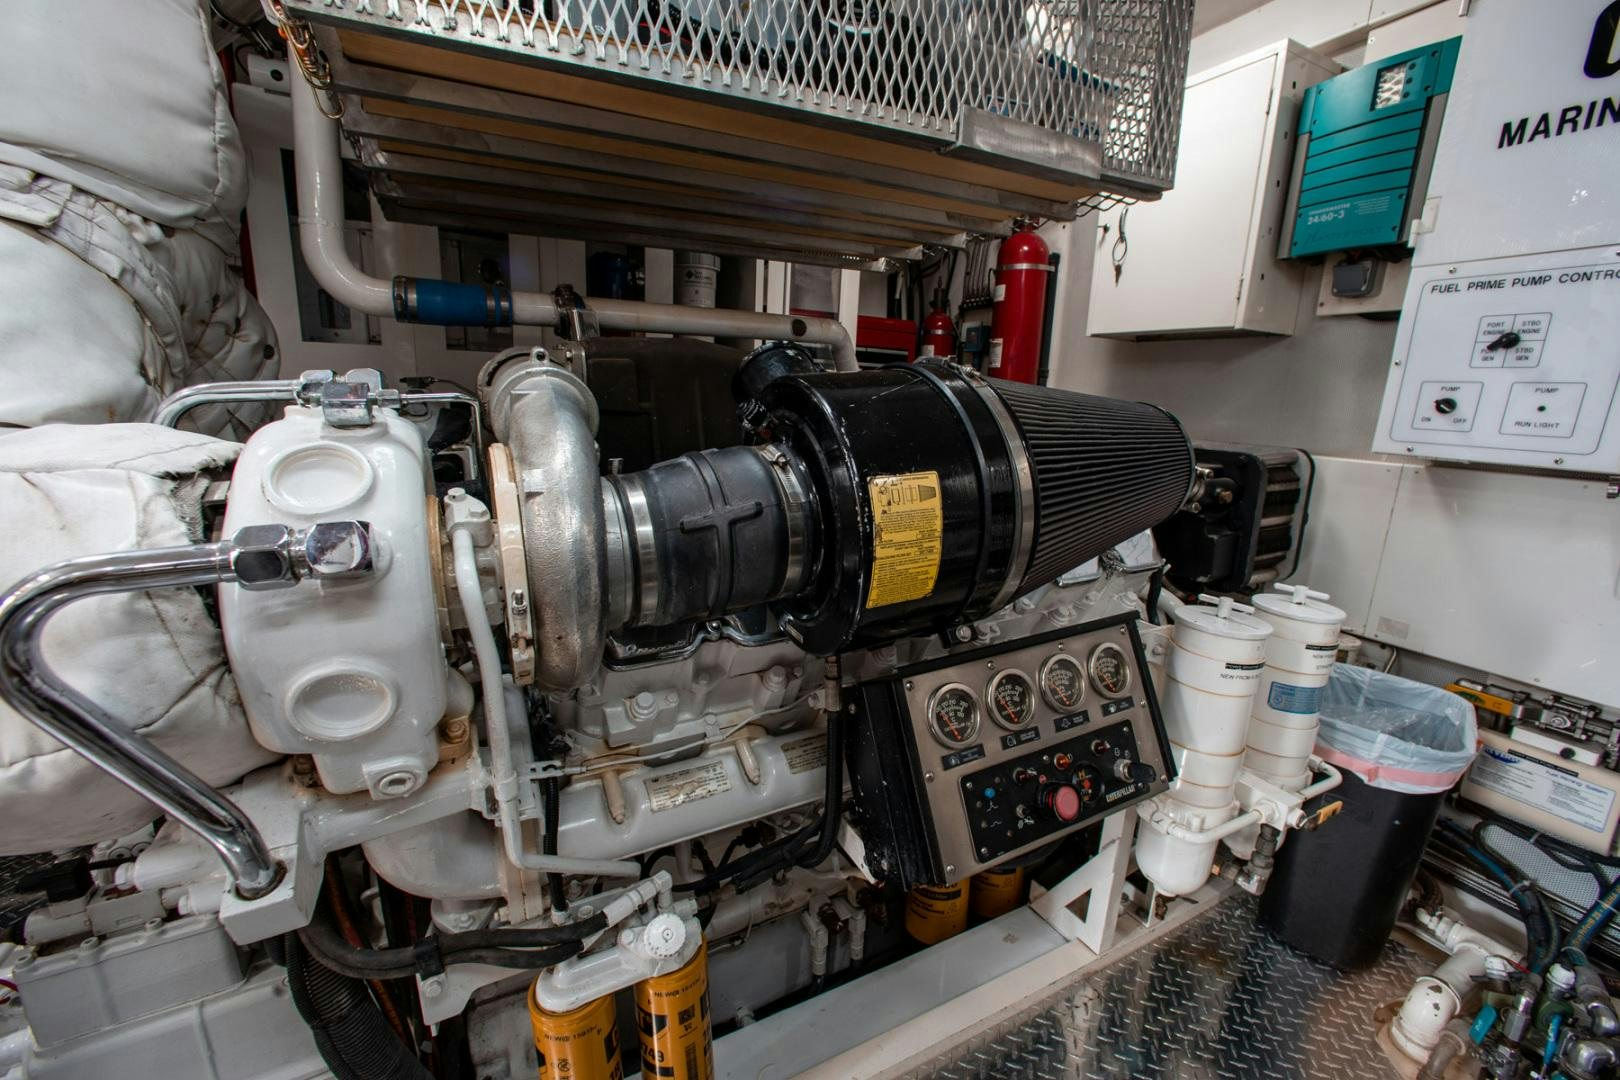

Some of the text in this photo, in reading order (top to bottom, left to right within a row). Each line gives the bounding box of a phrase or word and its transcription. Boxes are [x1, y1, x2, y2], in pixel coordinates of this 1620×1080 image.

[1431, 284, 1461, 294] FUEL
[1467, 279, 1507, 291] PRIME
[1512, 275, 1552, 288] PUMP
[1514, 420, 1560, 429] RUN LIGHT
